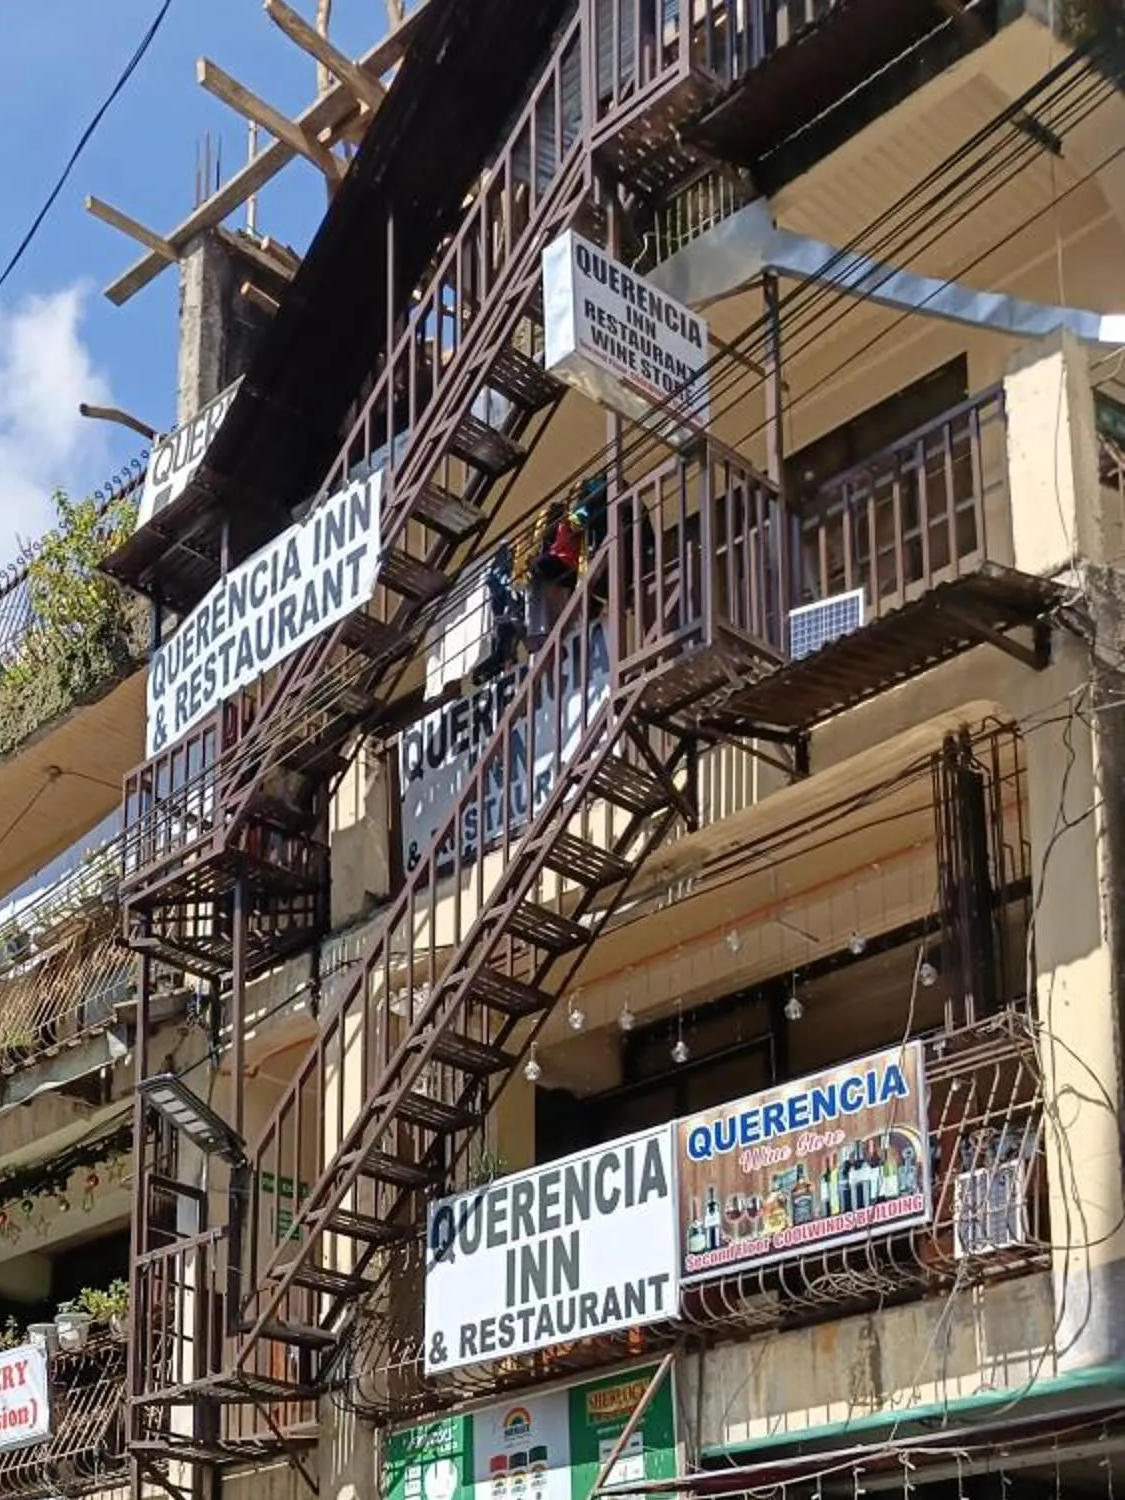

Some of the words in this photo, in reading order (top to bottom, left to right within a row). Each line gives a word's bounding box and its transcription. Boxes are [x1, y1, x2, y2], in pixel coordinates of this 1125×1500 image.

[576, 244, 703, 349] QUERENCIA
[585, 298, 697, 382] RESTAURANT
[626, 306, 656, 340] INN
[591, 326, 637, 370] WINE
[154, 398, 229, 486] QUER
[153, 537, 302, 699] QUERENCIA
[312, 480, 372, 567] INN
[153, 704, 168, 752] &
[175, 543, 368, 732] RESTAURANT
[687, 1063, 908, 1159] QUERENCIA
[431, 1137, 668, 1264] QUERENCIA
[506, 1230, 580, 1308] INN
[685, 1243, 730, 1272] Second
[429, 1331, 449, 1365] &
[459, 1273, 670, 1358] RESTAURANT
